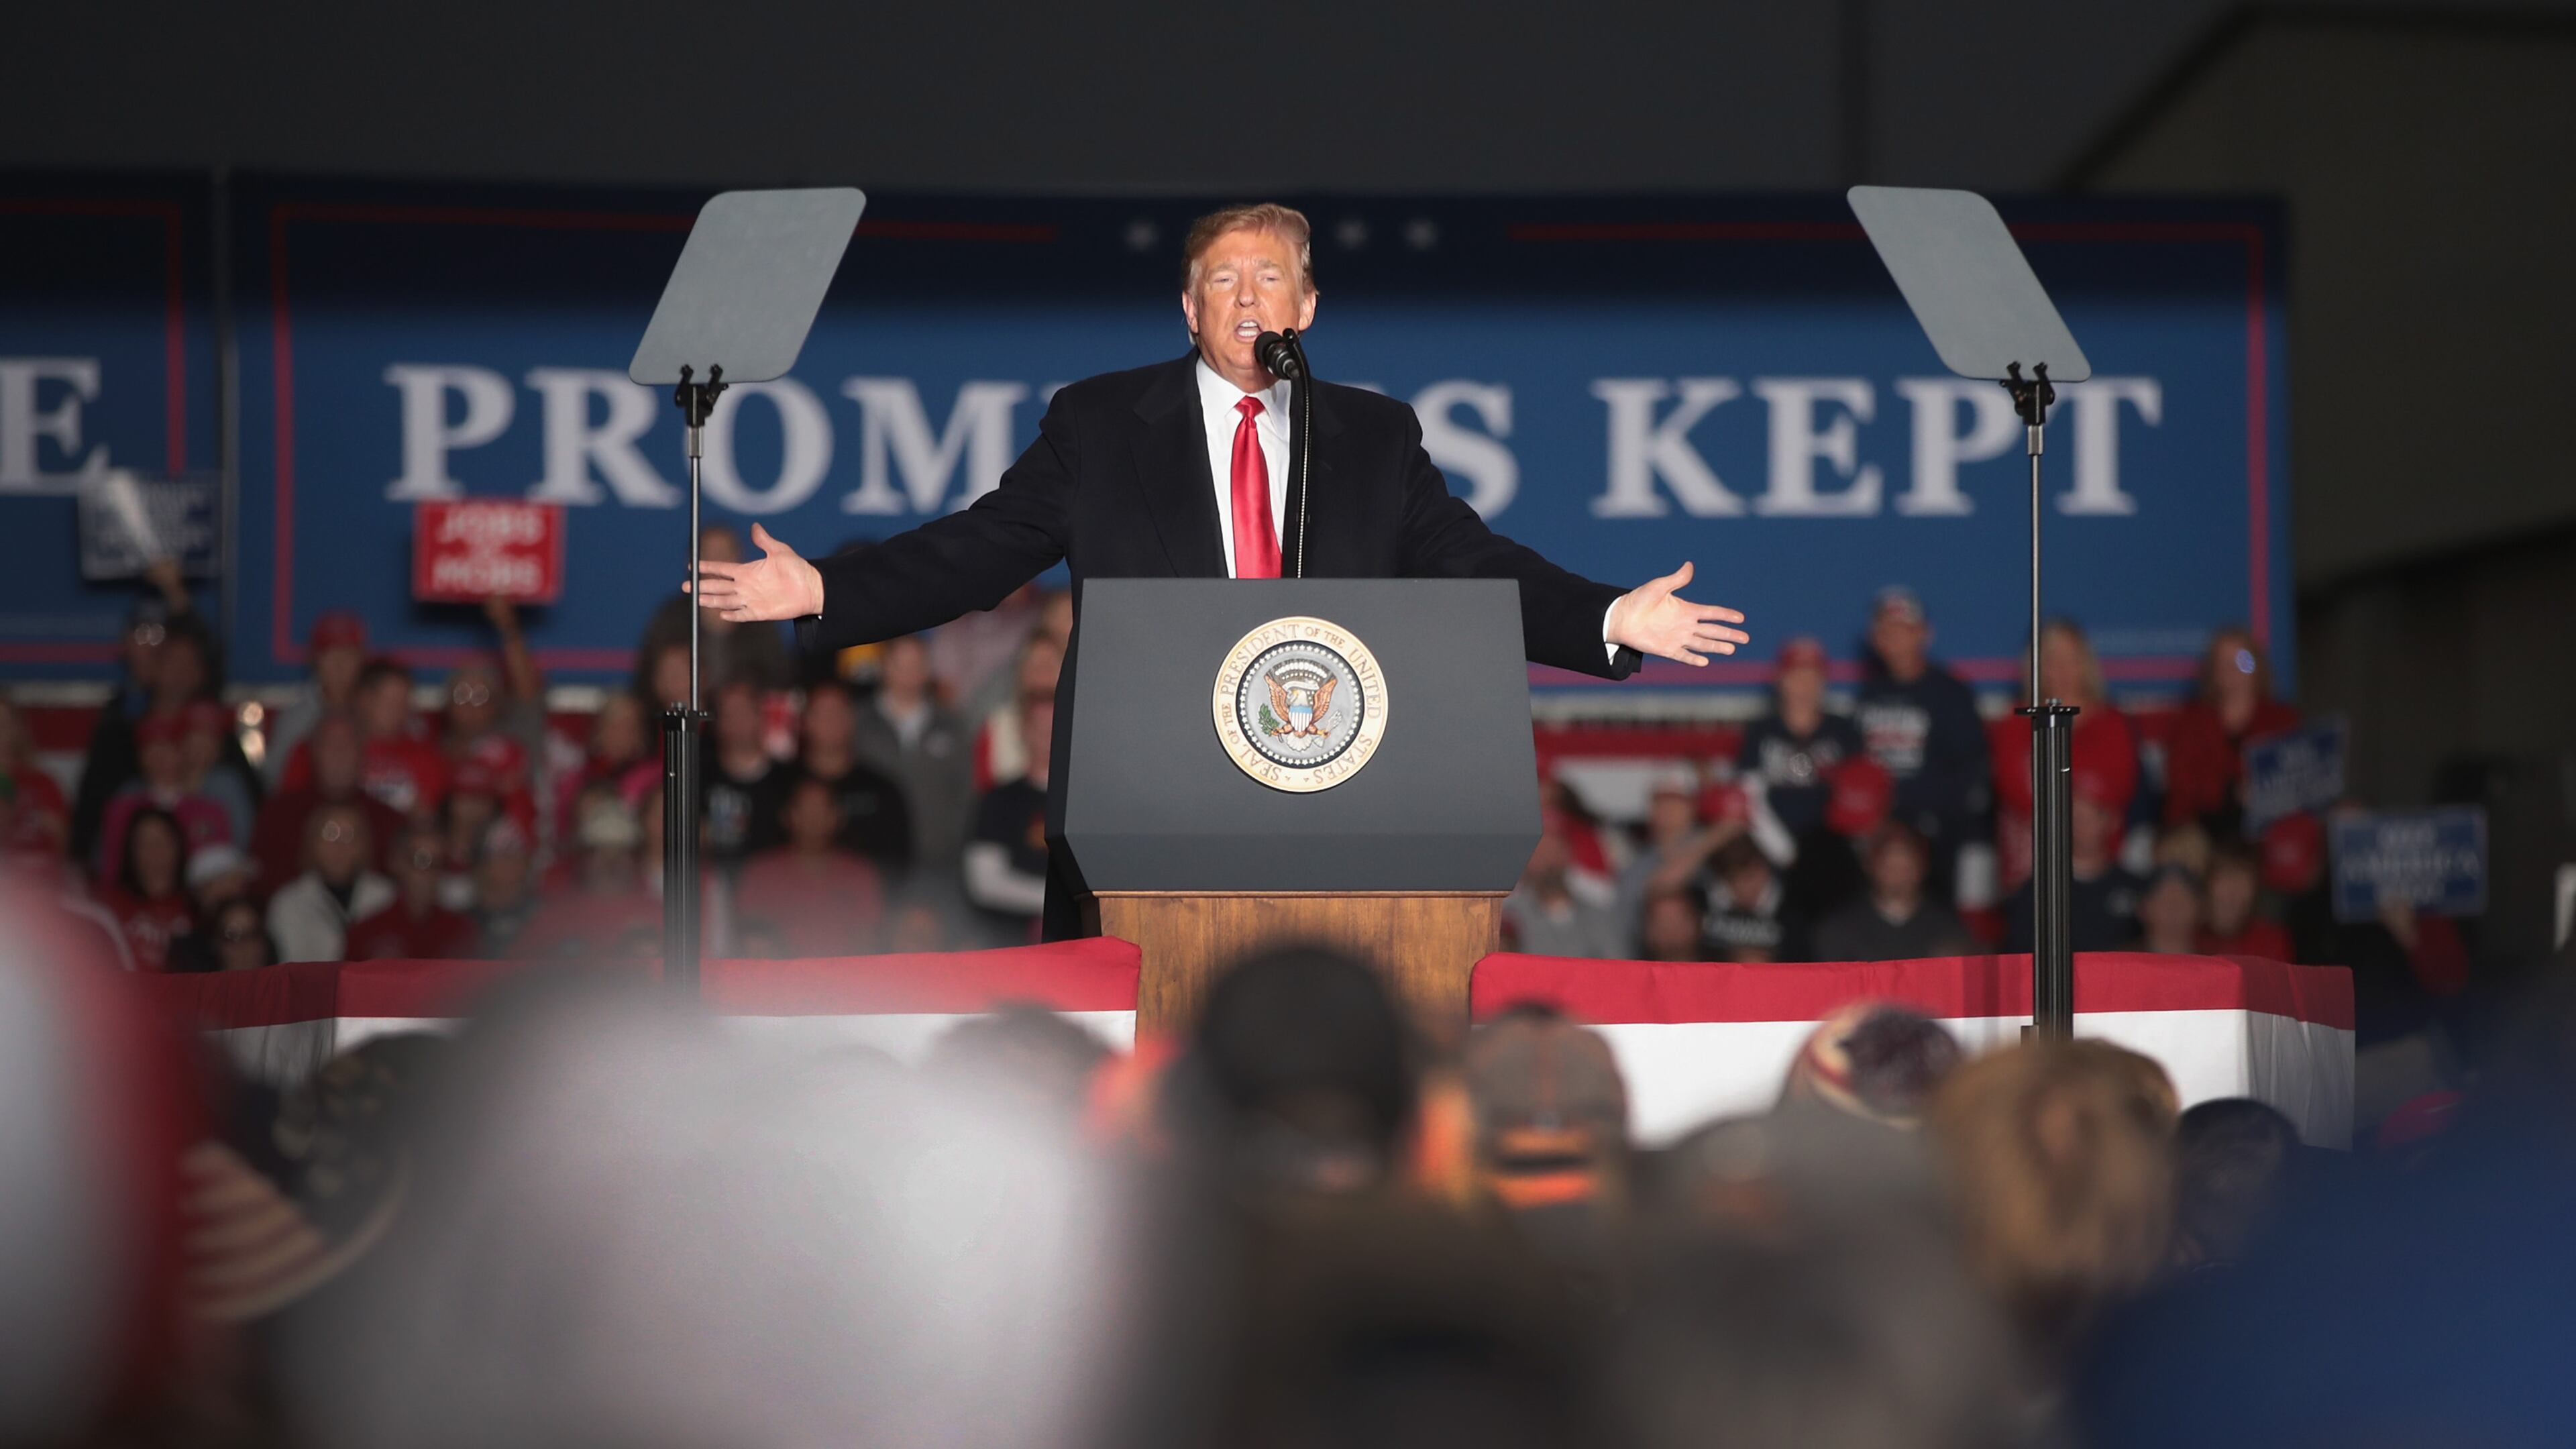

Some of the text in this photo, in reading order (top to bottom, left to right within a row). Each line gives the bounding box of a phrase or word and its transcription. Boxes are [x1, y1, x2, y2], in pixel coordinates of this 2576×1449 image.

[384, 363, 2164, 522] PROMS KEPT
[1220, 624, 1381, 784] SEAL OF THE PRESIDENT OF THE UNITED STATES
